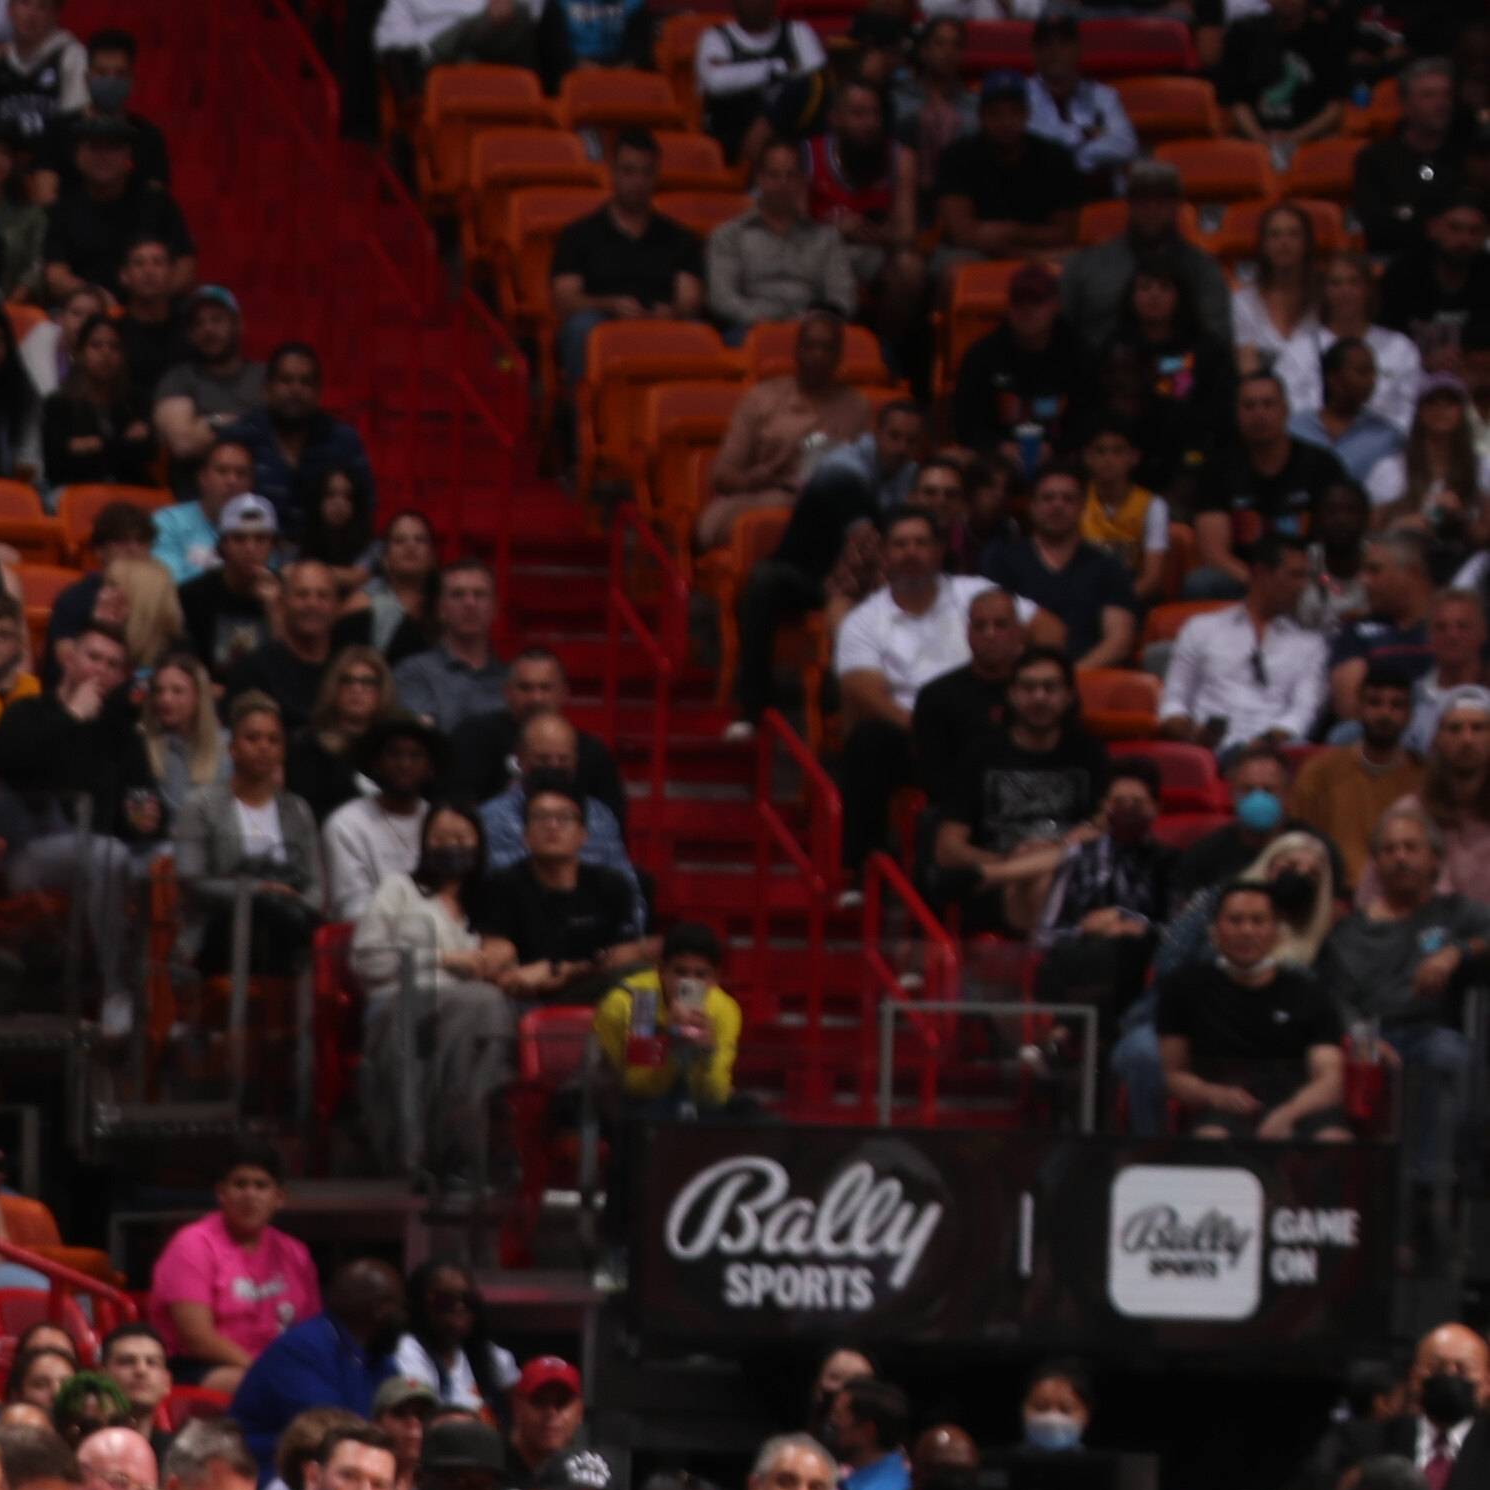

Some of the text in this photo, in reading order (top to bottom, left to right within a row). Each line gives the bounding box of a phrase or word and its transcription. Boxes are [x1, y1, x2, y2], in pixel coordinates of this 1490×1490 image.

[663, 1155, 944, 1290] Bally
[1121, 1203, 1254, 1269] Bally
[1271, 1207, 1361, 1246] GAME
[724, 1263, 875, 1311] SPORTS
[1271, 1247, 1318, 1285] ON
